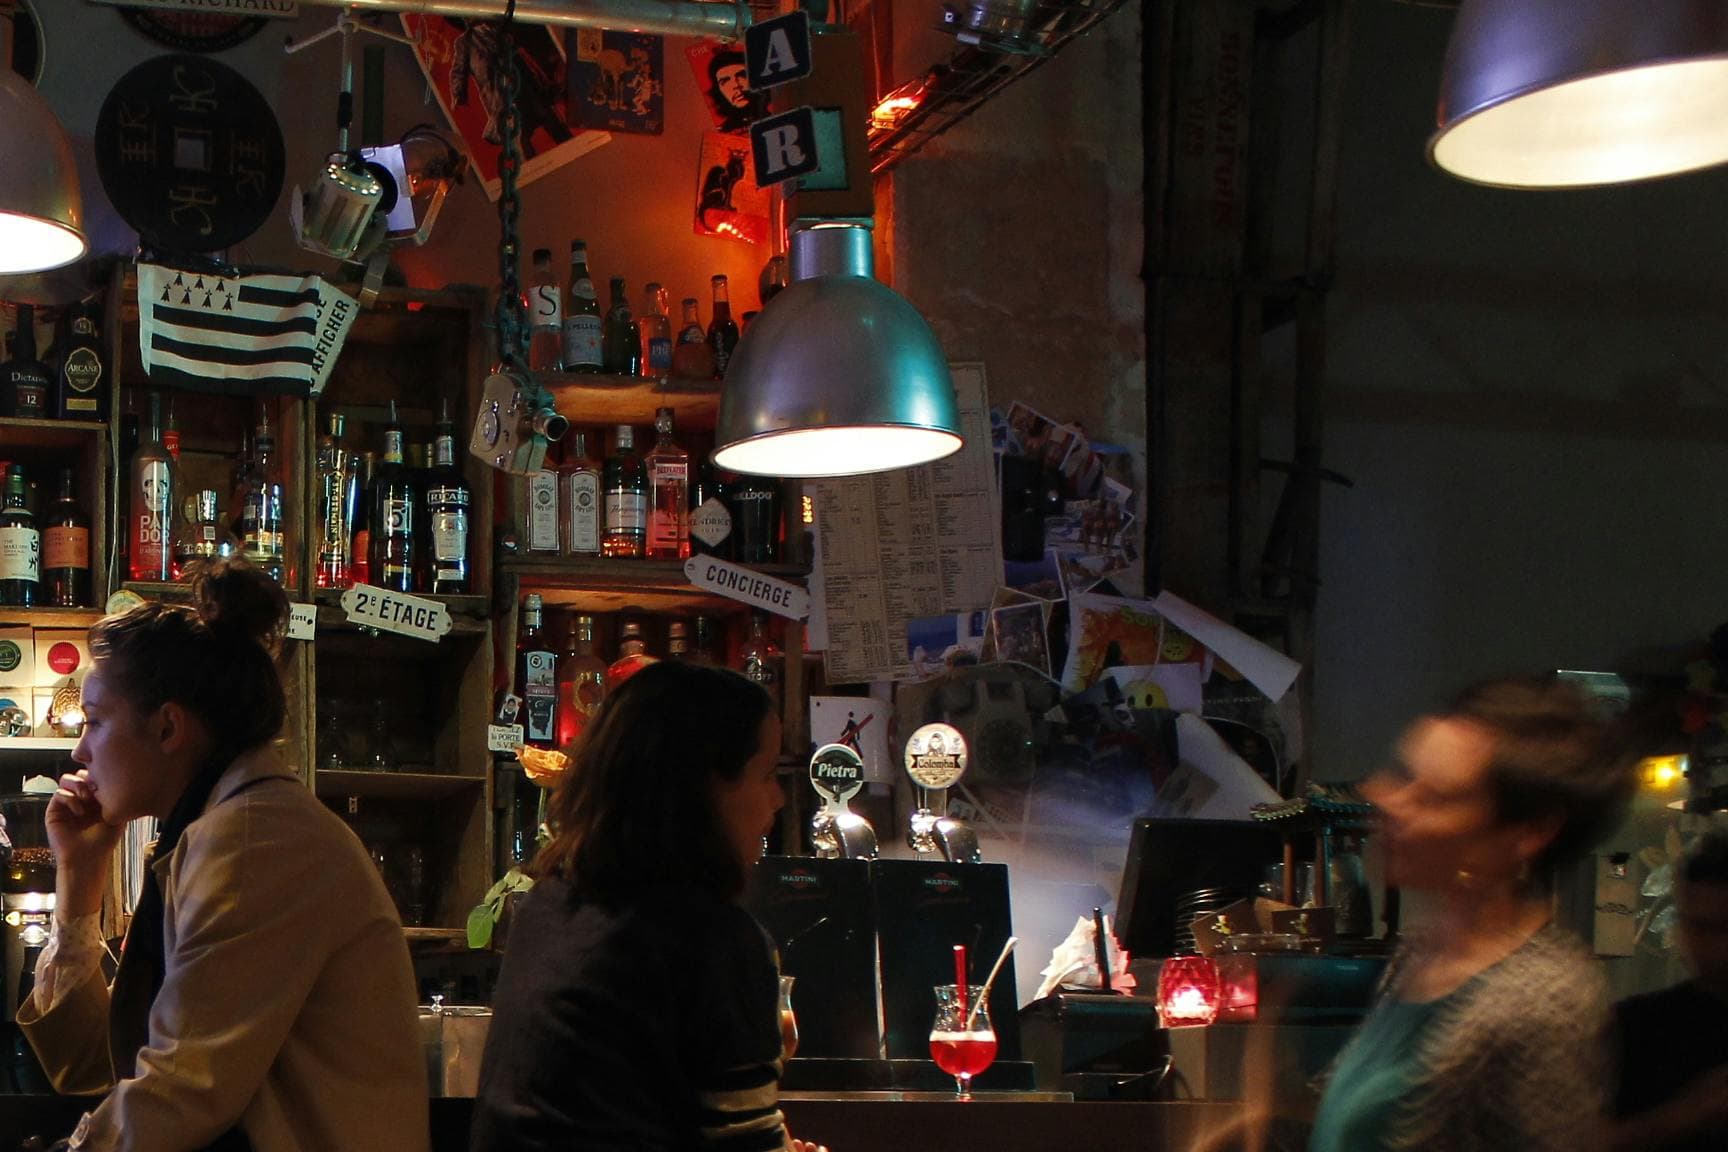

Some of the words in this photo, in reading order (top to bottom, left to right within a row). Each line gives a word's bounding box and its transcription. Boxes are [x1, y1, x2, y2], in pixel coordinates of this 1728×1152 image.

[761, 29, 797, 78] A
[762, 124, 806, 175] R
[310, 299, 350, 384] AFFICHER
[430, 492, 469, 502] RICARD
[706, 565, 793, 608] CONCIERGE
[379, 597, 438, 631] ÉTAGE
[498, 734, 521, 742] PORTE
[817, 763, 858, 779] Pietra
[781, 874, 817, 884] MARTINI
